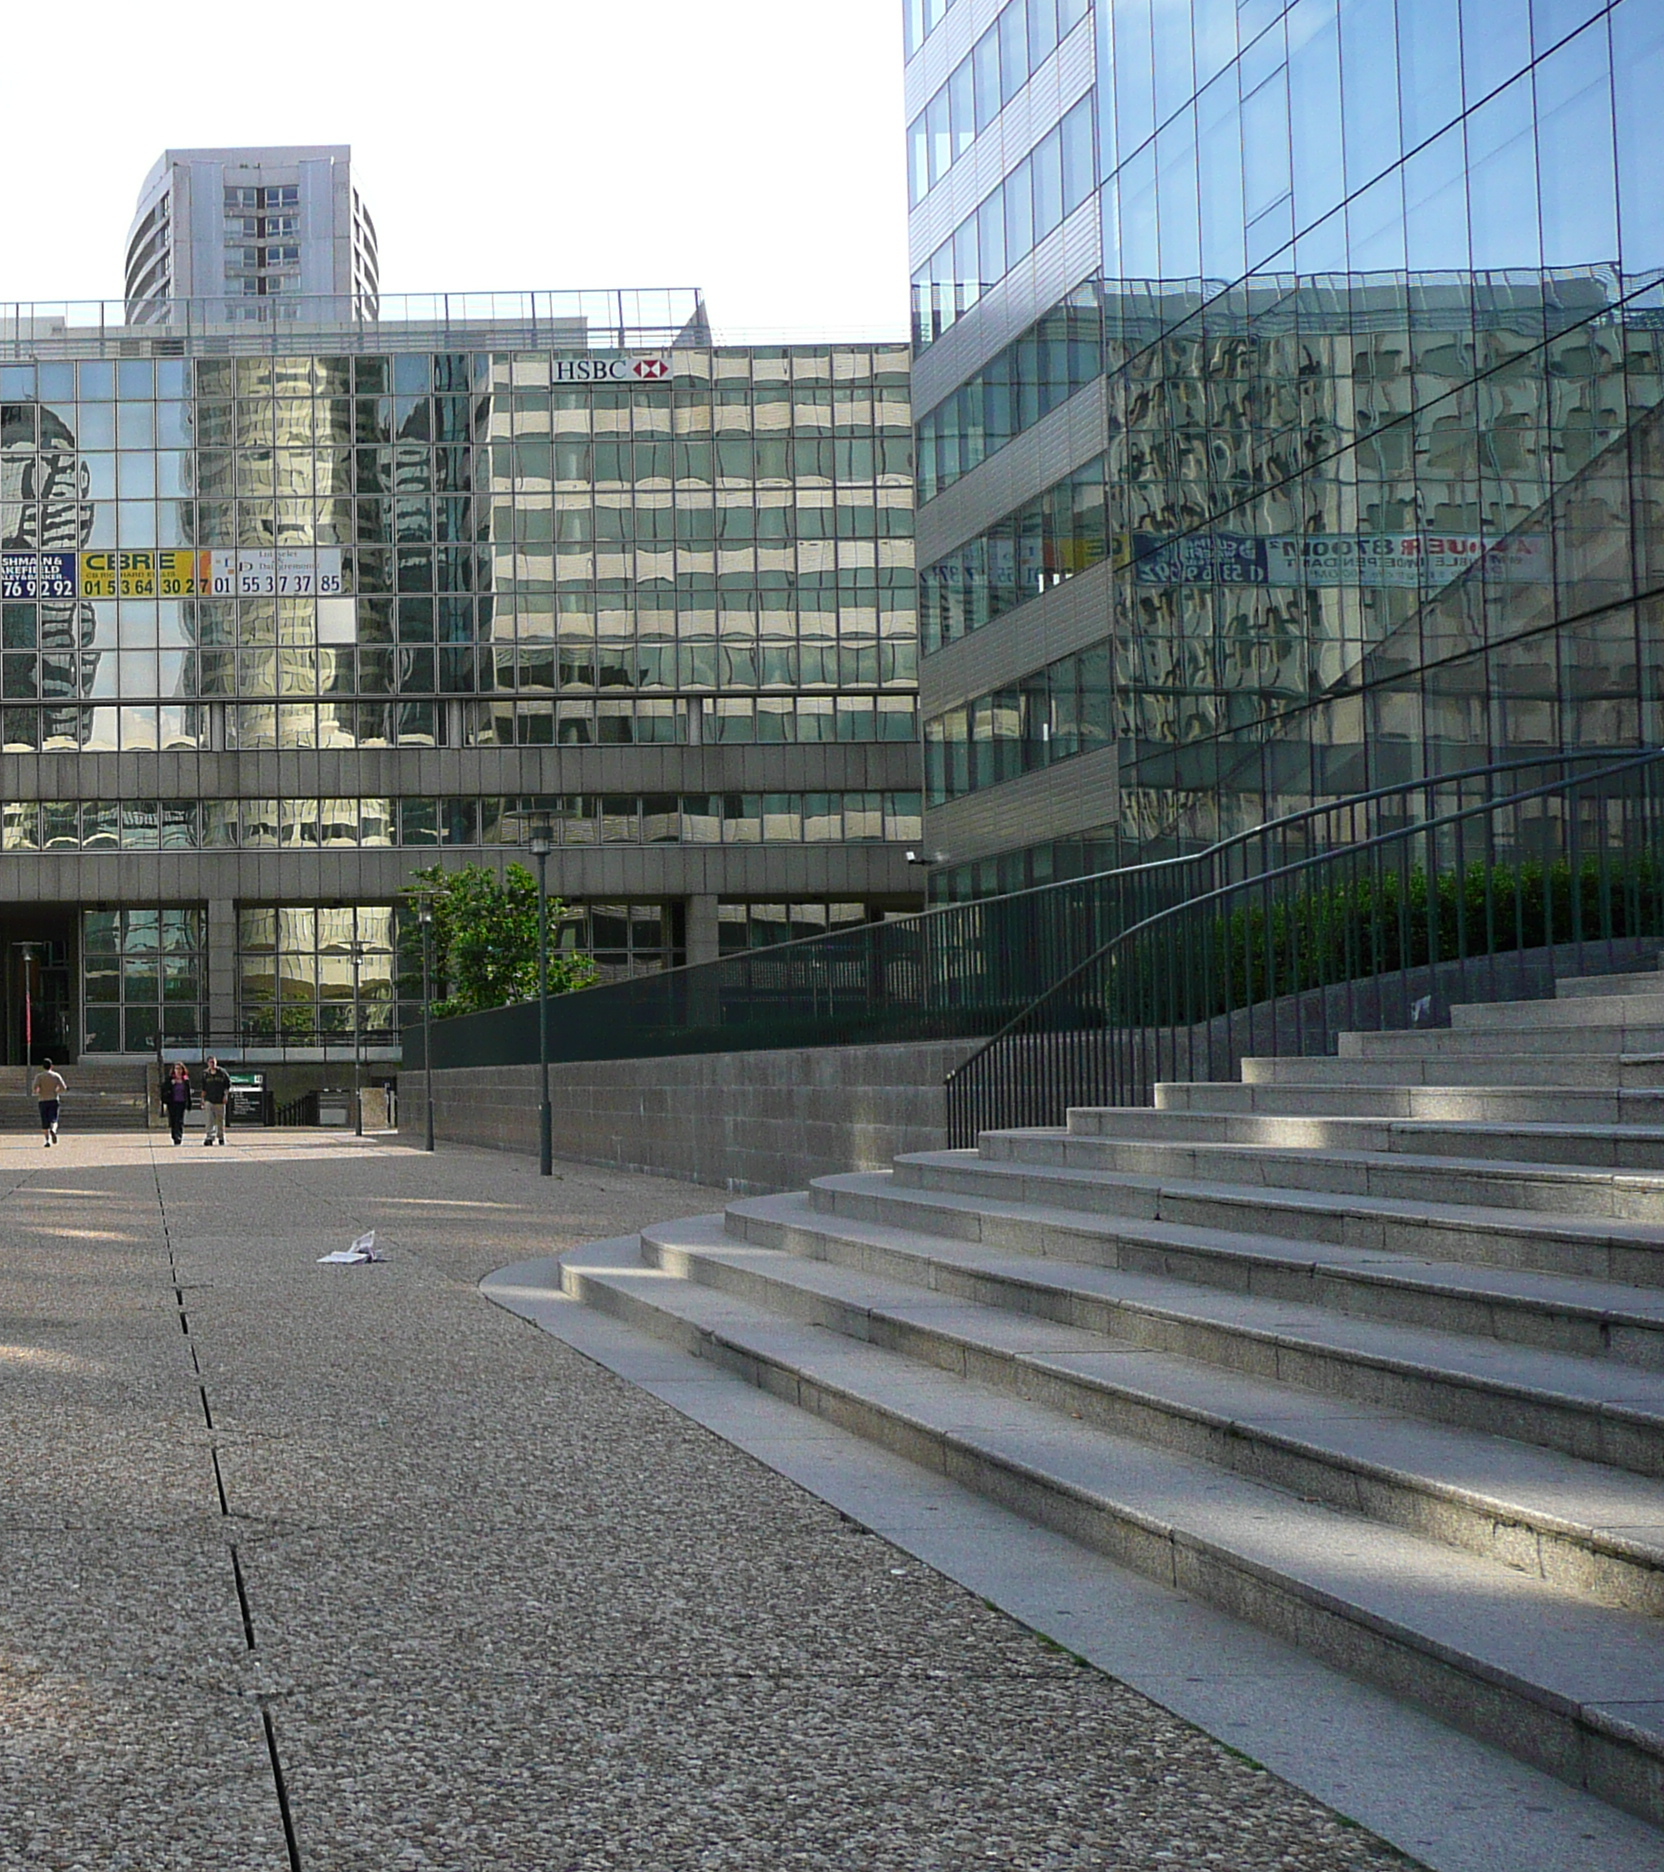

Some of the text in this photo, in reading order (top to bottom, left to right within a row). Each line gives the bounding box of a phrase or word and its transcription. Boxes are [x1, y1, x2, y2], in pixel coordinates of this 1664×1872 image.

[557, 360, 626, 380] HSBC
[86, 553, 175, 571] CBRE
[3, 581, 22, 597] 76
[26, 580, 51, 597] 92
[53, 580, 73, 596] 92
[84, 578, 209, 596] 01 53 64 30 27
[214, 575, 340, 593] 01 55 37 37 85
